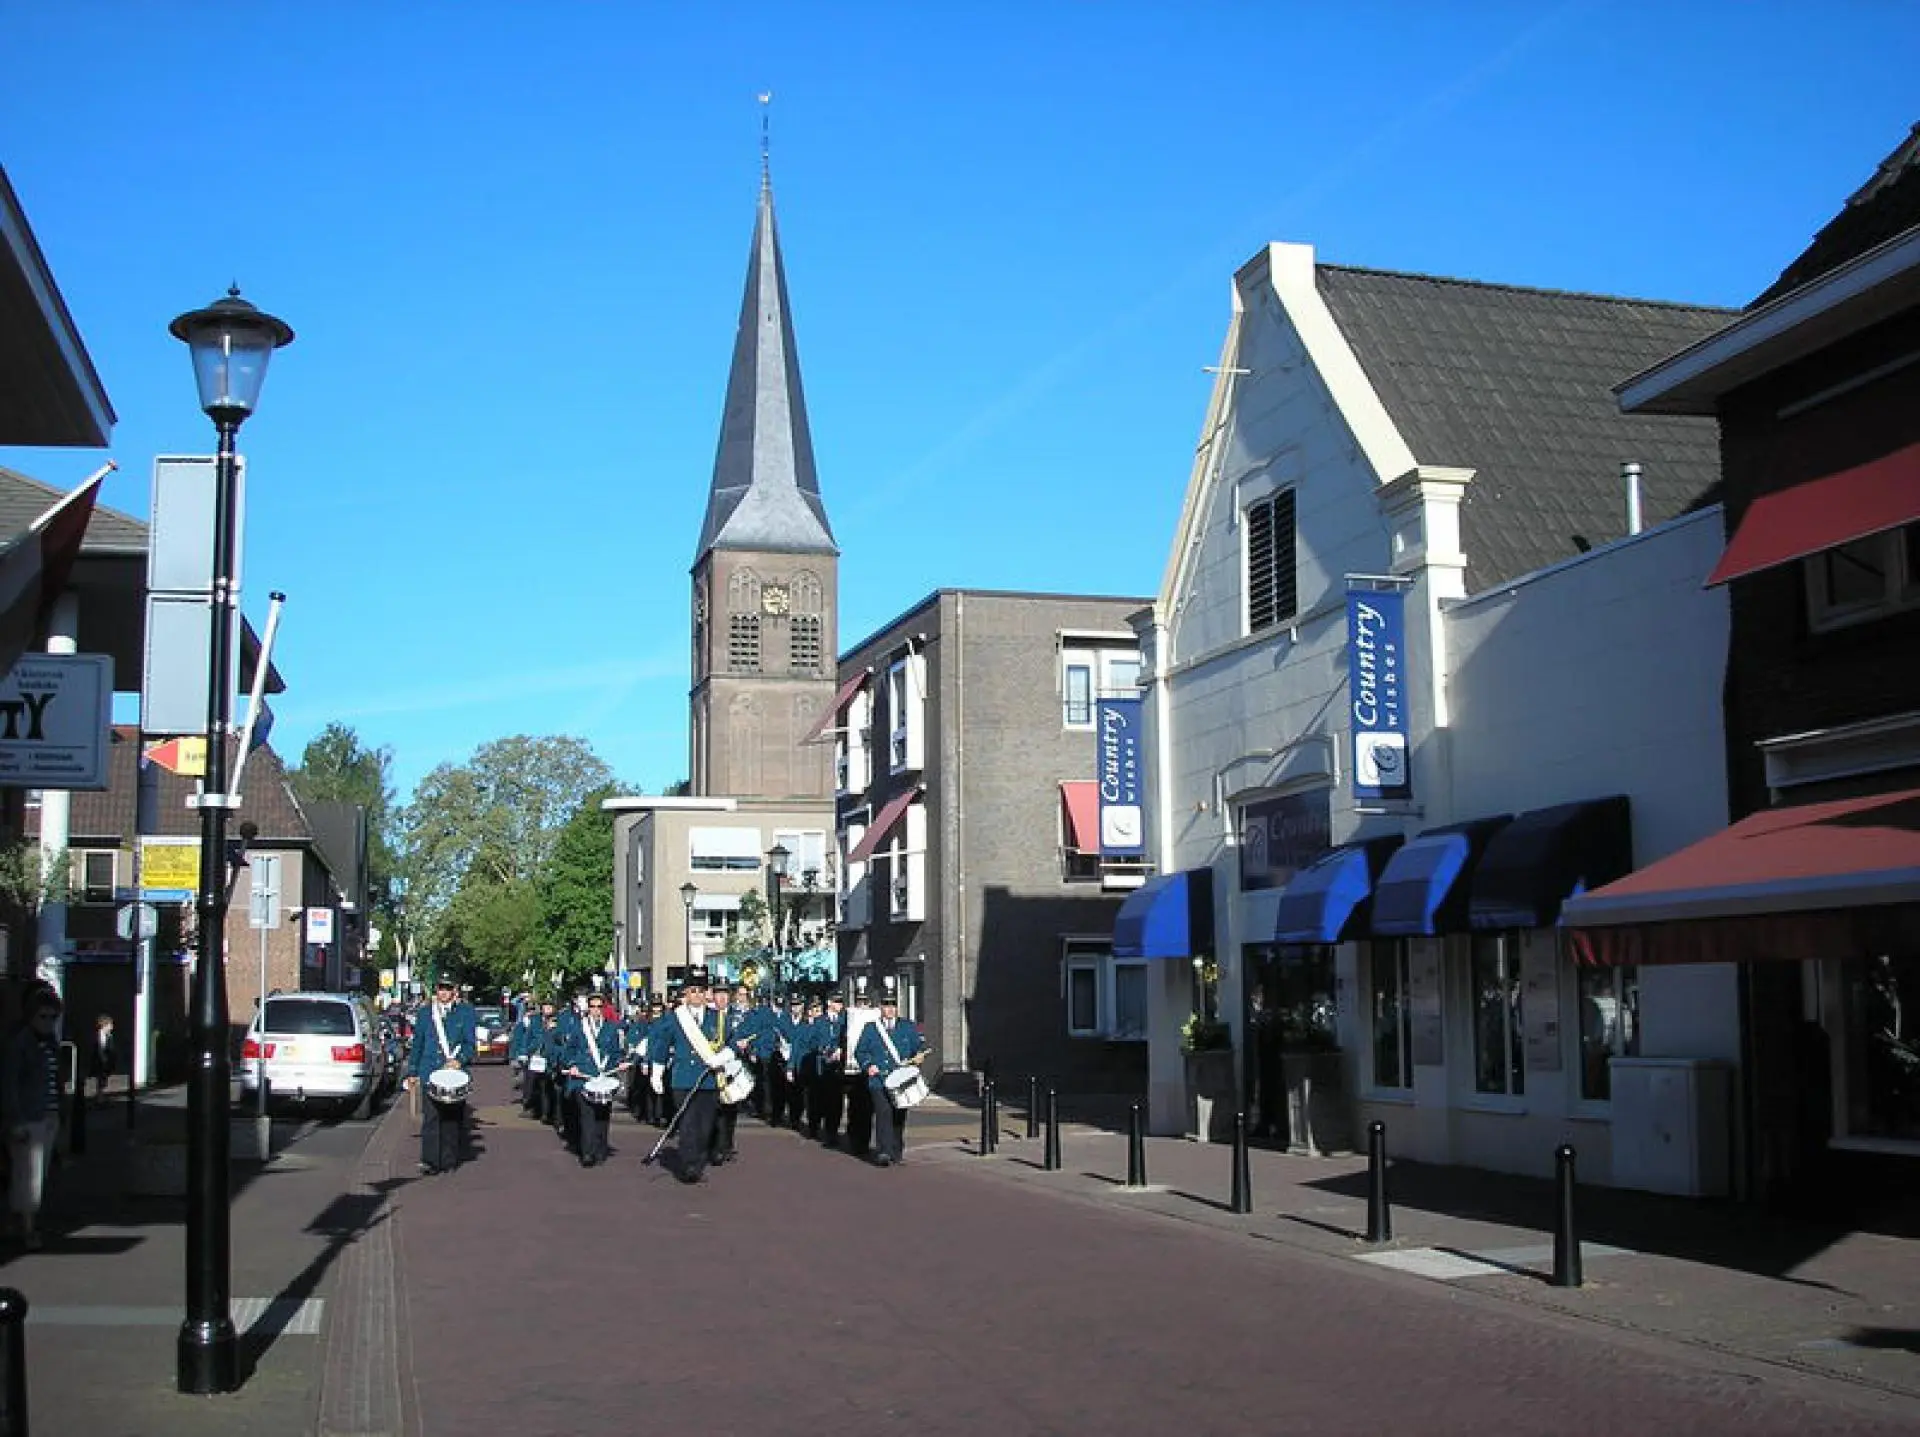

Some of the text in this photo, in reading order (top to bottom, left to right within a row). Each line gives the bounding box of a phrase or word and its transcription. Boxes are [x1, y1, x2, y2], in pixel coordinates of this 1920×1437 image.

[1354, 601, 1386, 726] Country
[1384, 643, 1398, 727] wishes
[1101, 707, 1127, 802] Country
